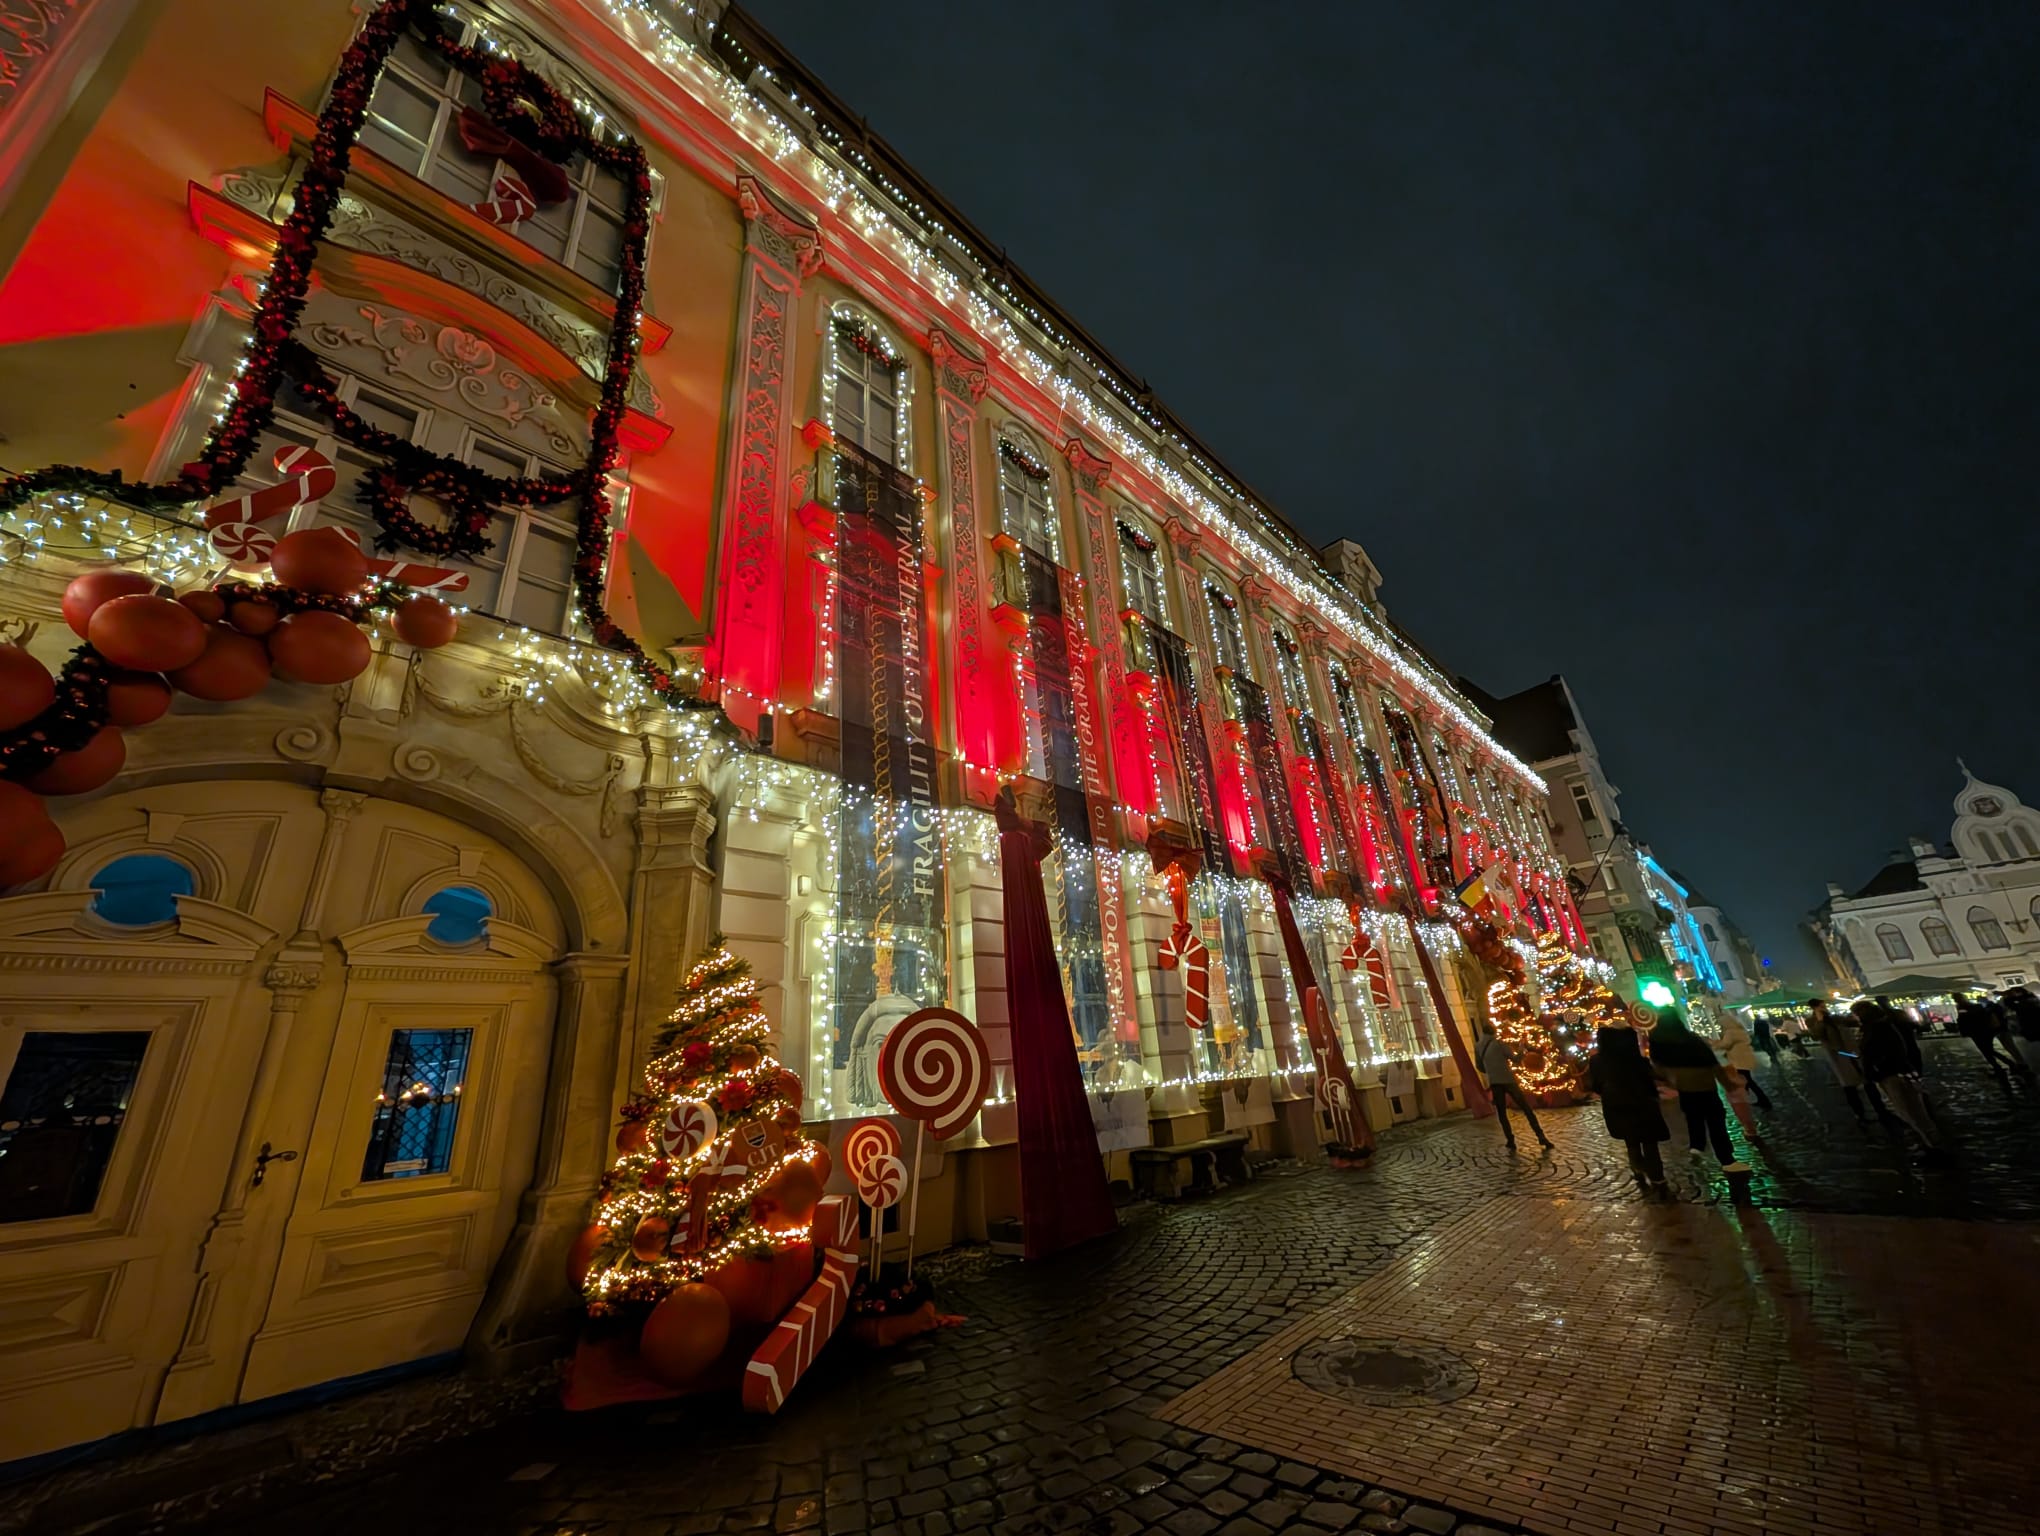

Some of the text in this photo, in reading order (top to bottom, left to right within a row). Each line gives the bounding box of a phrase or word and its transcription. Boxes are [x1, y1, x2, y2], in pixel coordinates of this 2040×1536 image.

[895, 512, 935, 896] FRAGILITY OF THE ETERNAL
[1073, 665, 1095, 747] GRAND
[1083, 751, 1101, 797] THE
[1193, 752, 1214, 821] TODAY
[1095, 806, 1107, 831] TO
[1096, 836, 1120, 954] POMPII
[1113, 958, 1126, 1016] FROM
[747, 1142, 777, 1167] CJT
